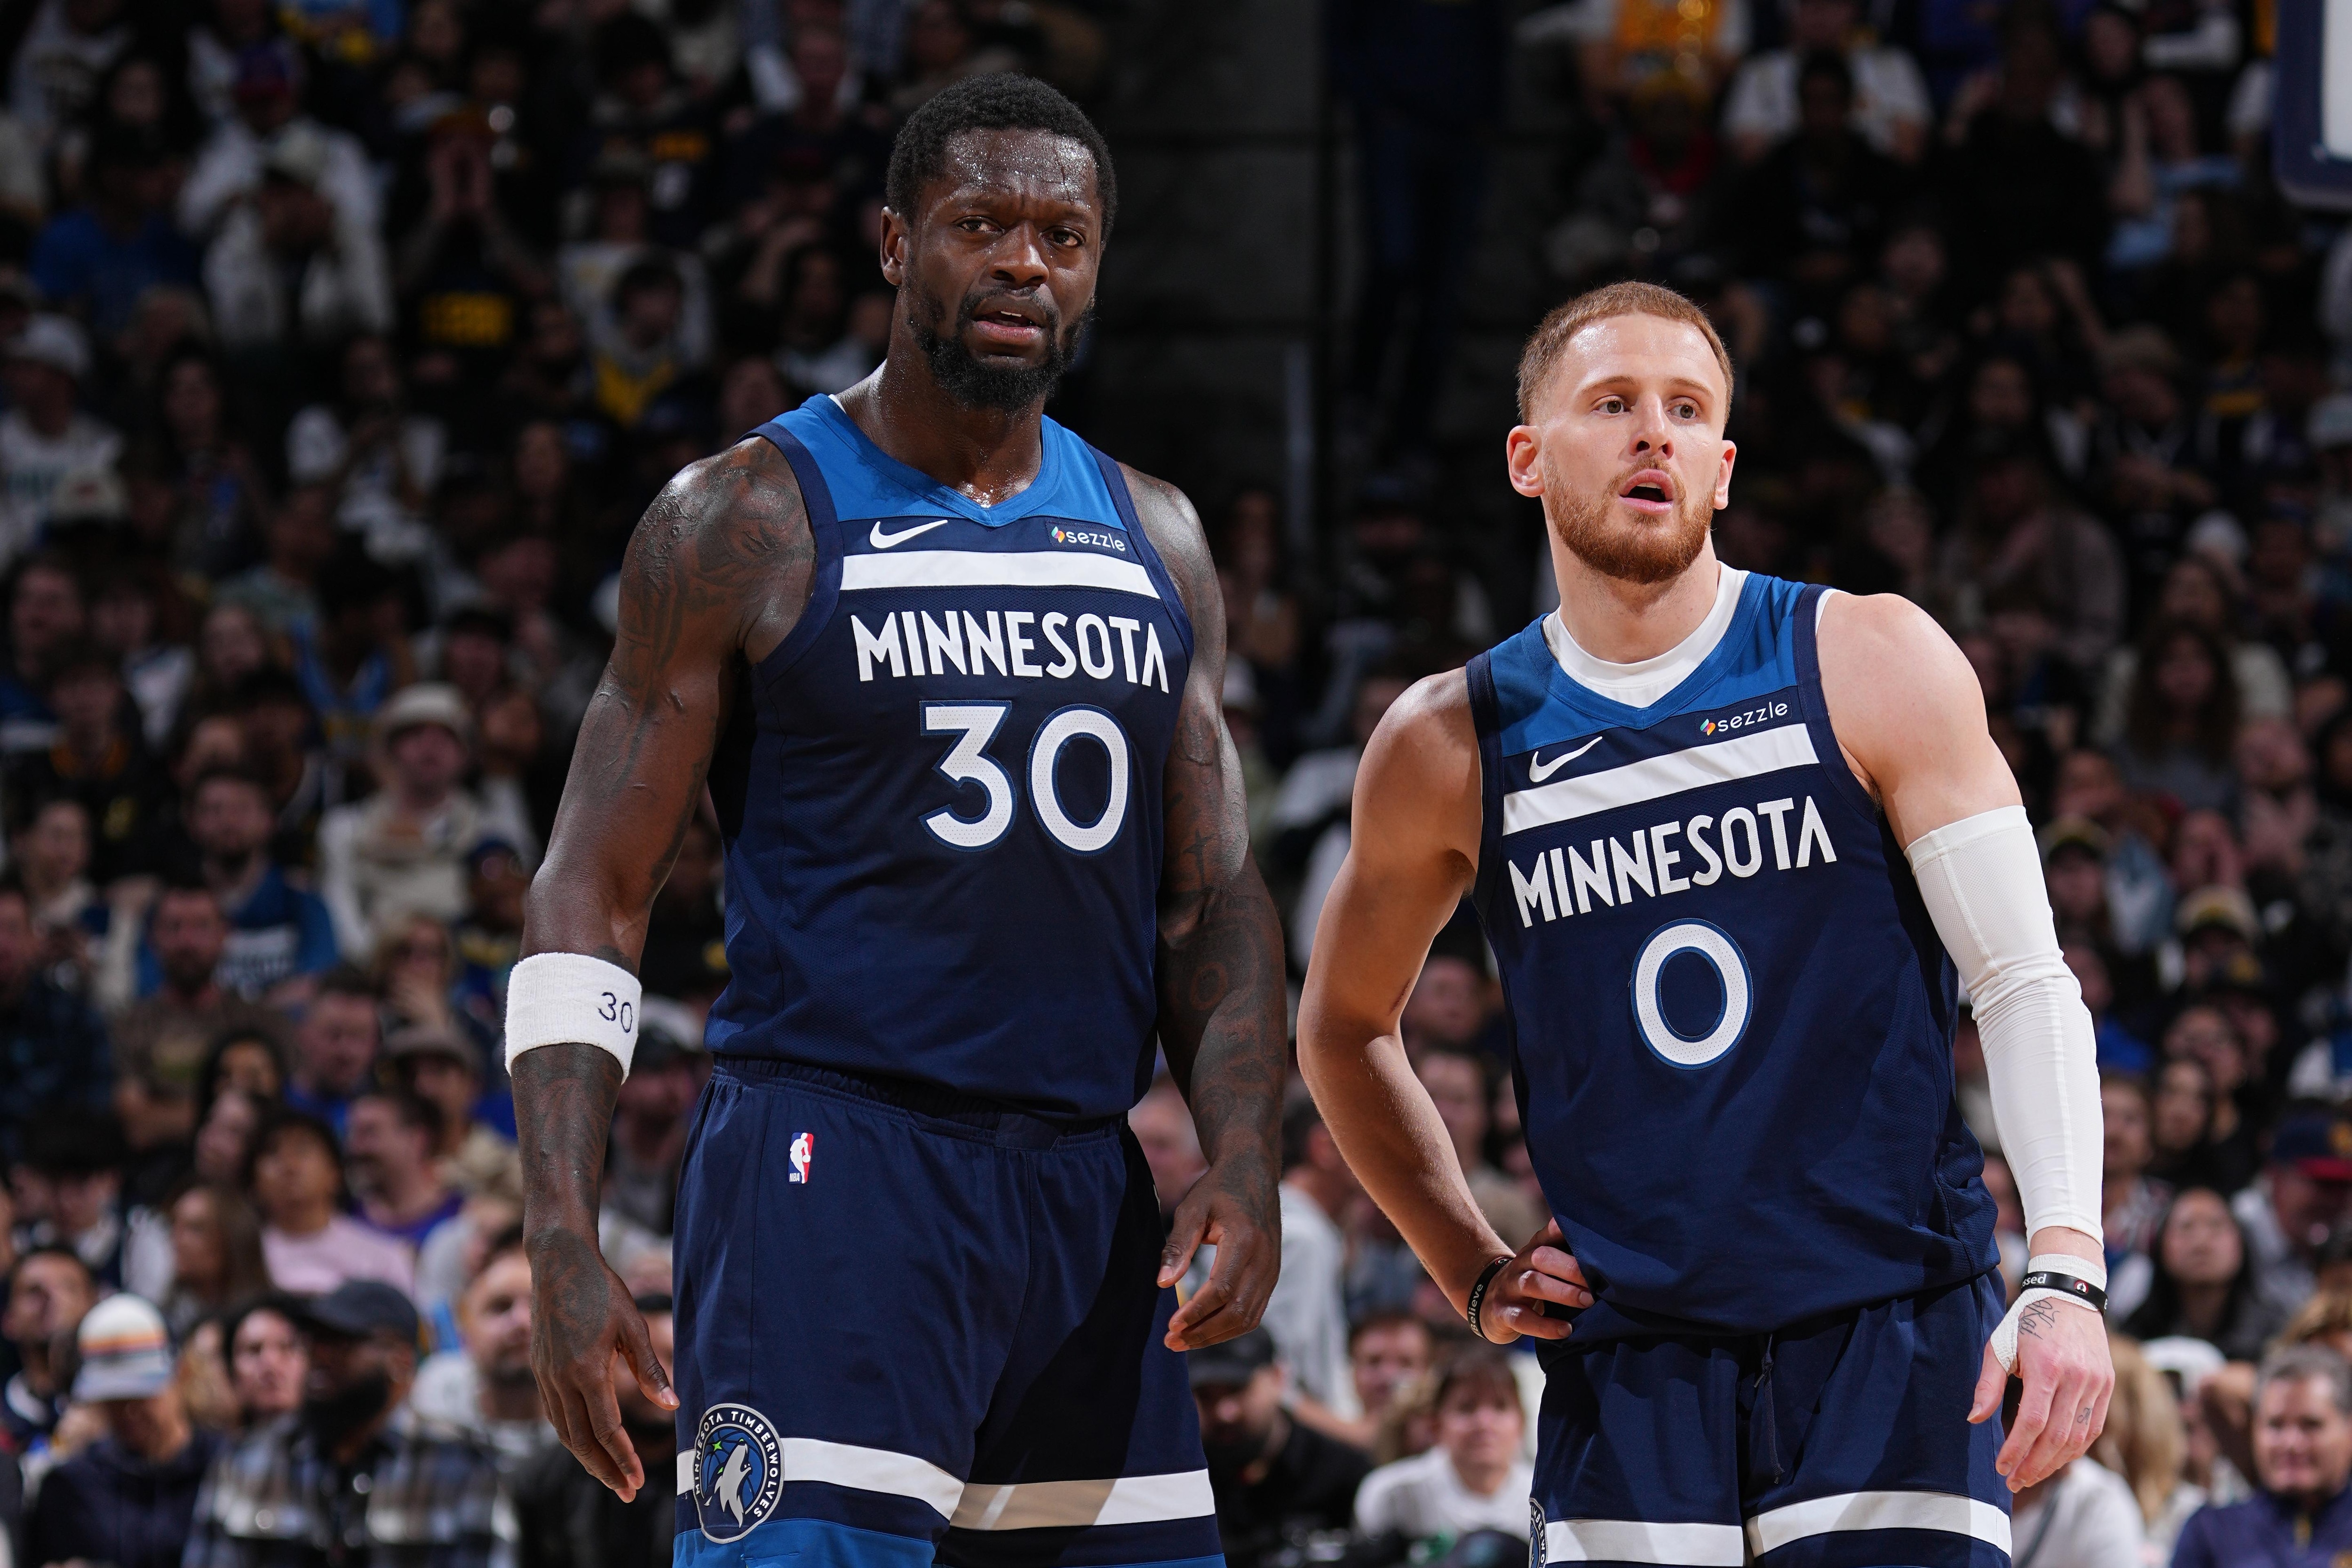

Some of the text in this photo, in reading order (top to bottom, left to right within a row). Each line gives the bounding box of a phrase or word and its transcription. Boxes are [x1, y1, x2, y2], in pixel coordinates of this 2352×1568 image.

[1066, 530, 1125, 552] sezzle
[851, 610, 1169, 694] MINNESOTA
[1717, 701, 1788, 732] sezzle
[919, 700, 1133, 855] 30
[1508, 796, 1837, 928] MINNESOTA
[598, 991, 633, 1033] 30
[1631, 918, 1753, 1070] 0
[789, 1173, 800, 1182] NBA
[1468, 1284, 1484, 1332] Believe
[695, 1411, 778, 1518] MINNESOTA TIMBERWOLVES
